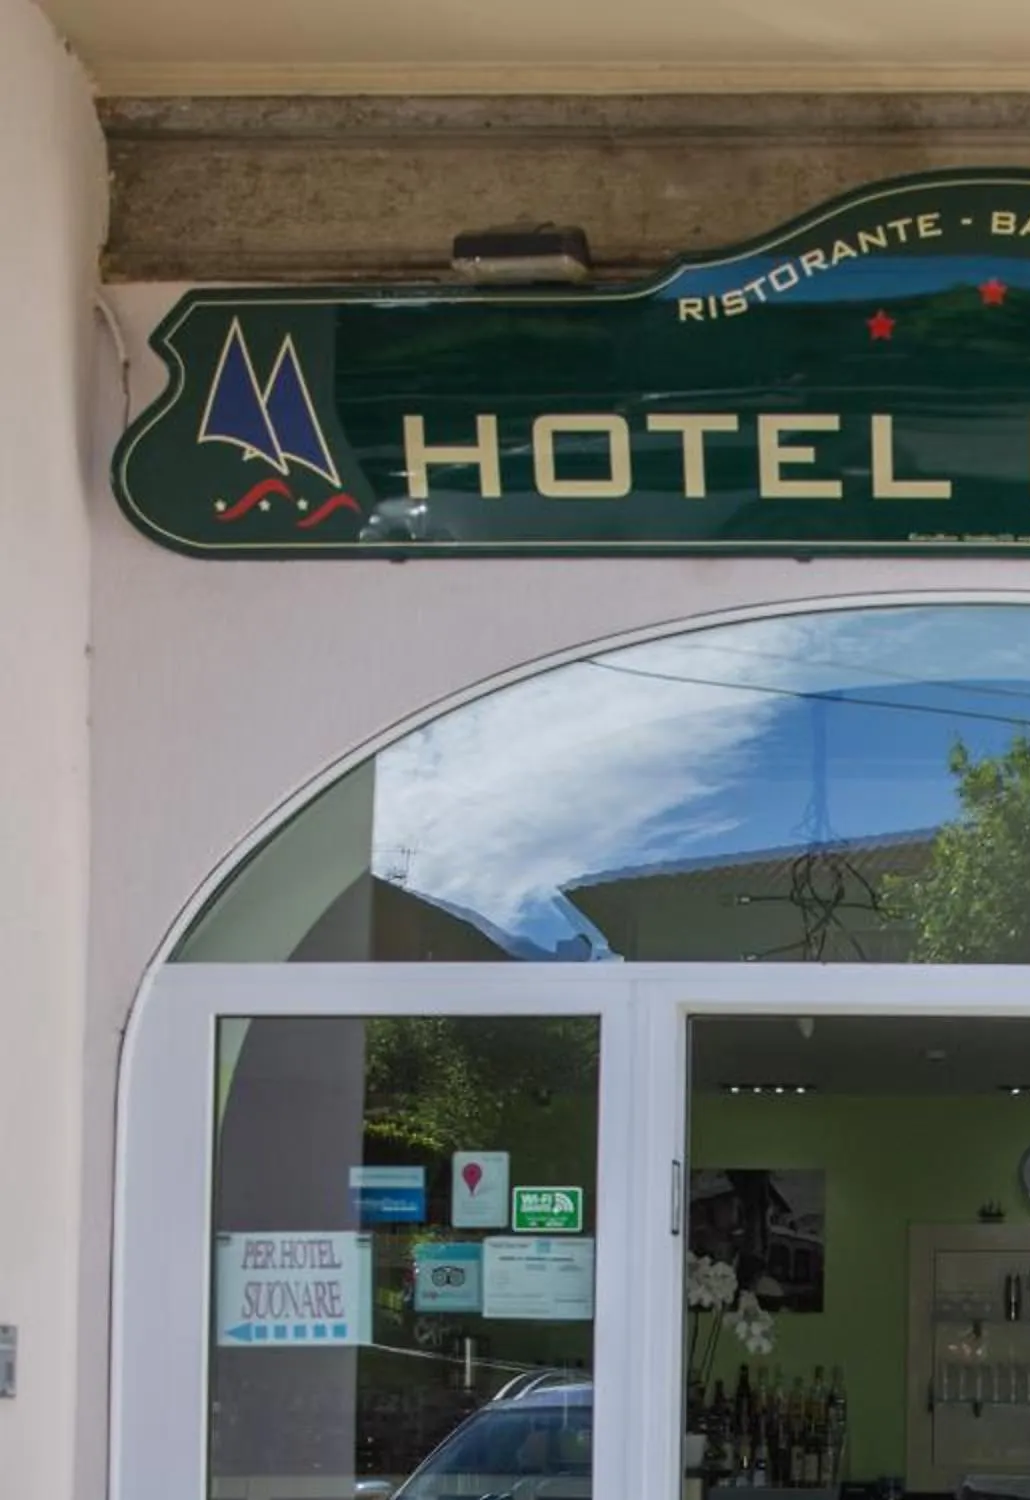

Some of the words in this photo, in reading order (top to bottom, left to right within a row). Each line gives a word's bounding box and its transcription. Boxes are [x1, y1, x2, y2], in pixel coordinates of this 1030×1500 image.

[677, 212, 943, 323] RISTORANTE
[403, 413, 952, 499] HOTEL
[241, 1240, 277, 1269] PER
[279, 1240, 342, 1269] HOTEL
[241, 1280, 345, 1319] SUONARE
